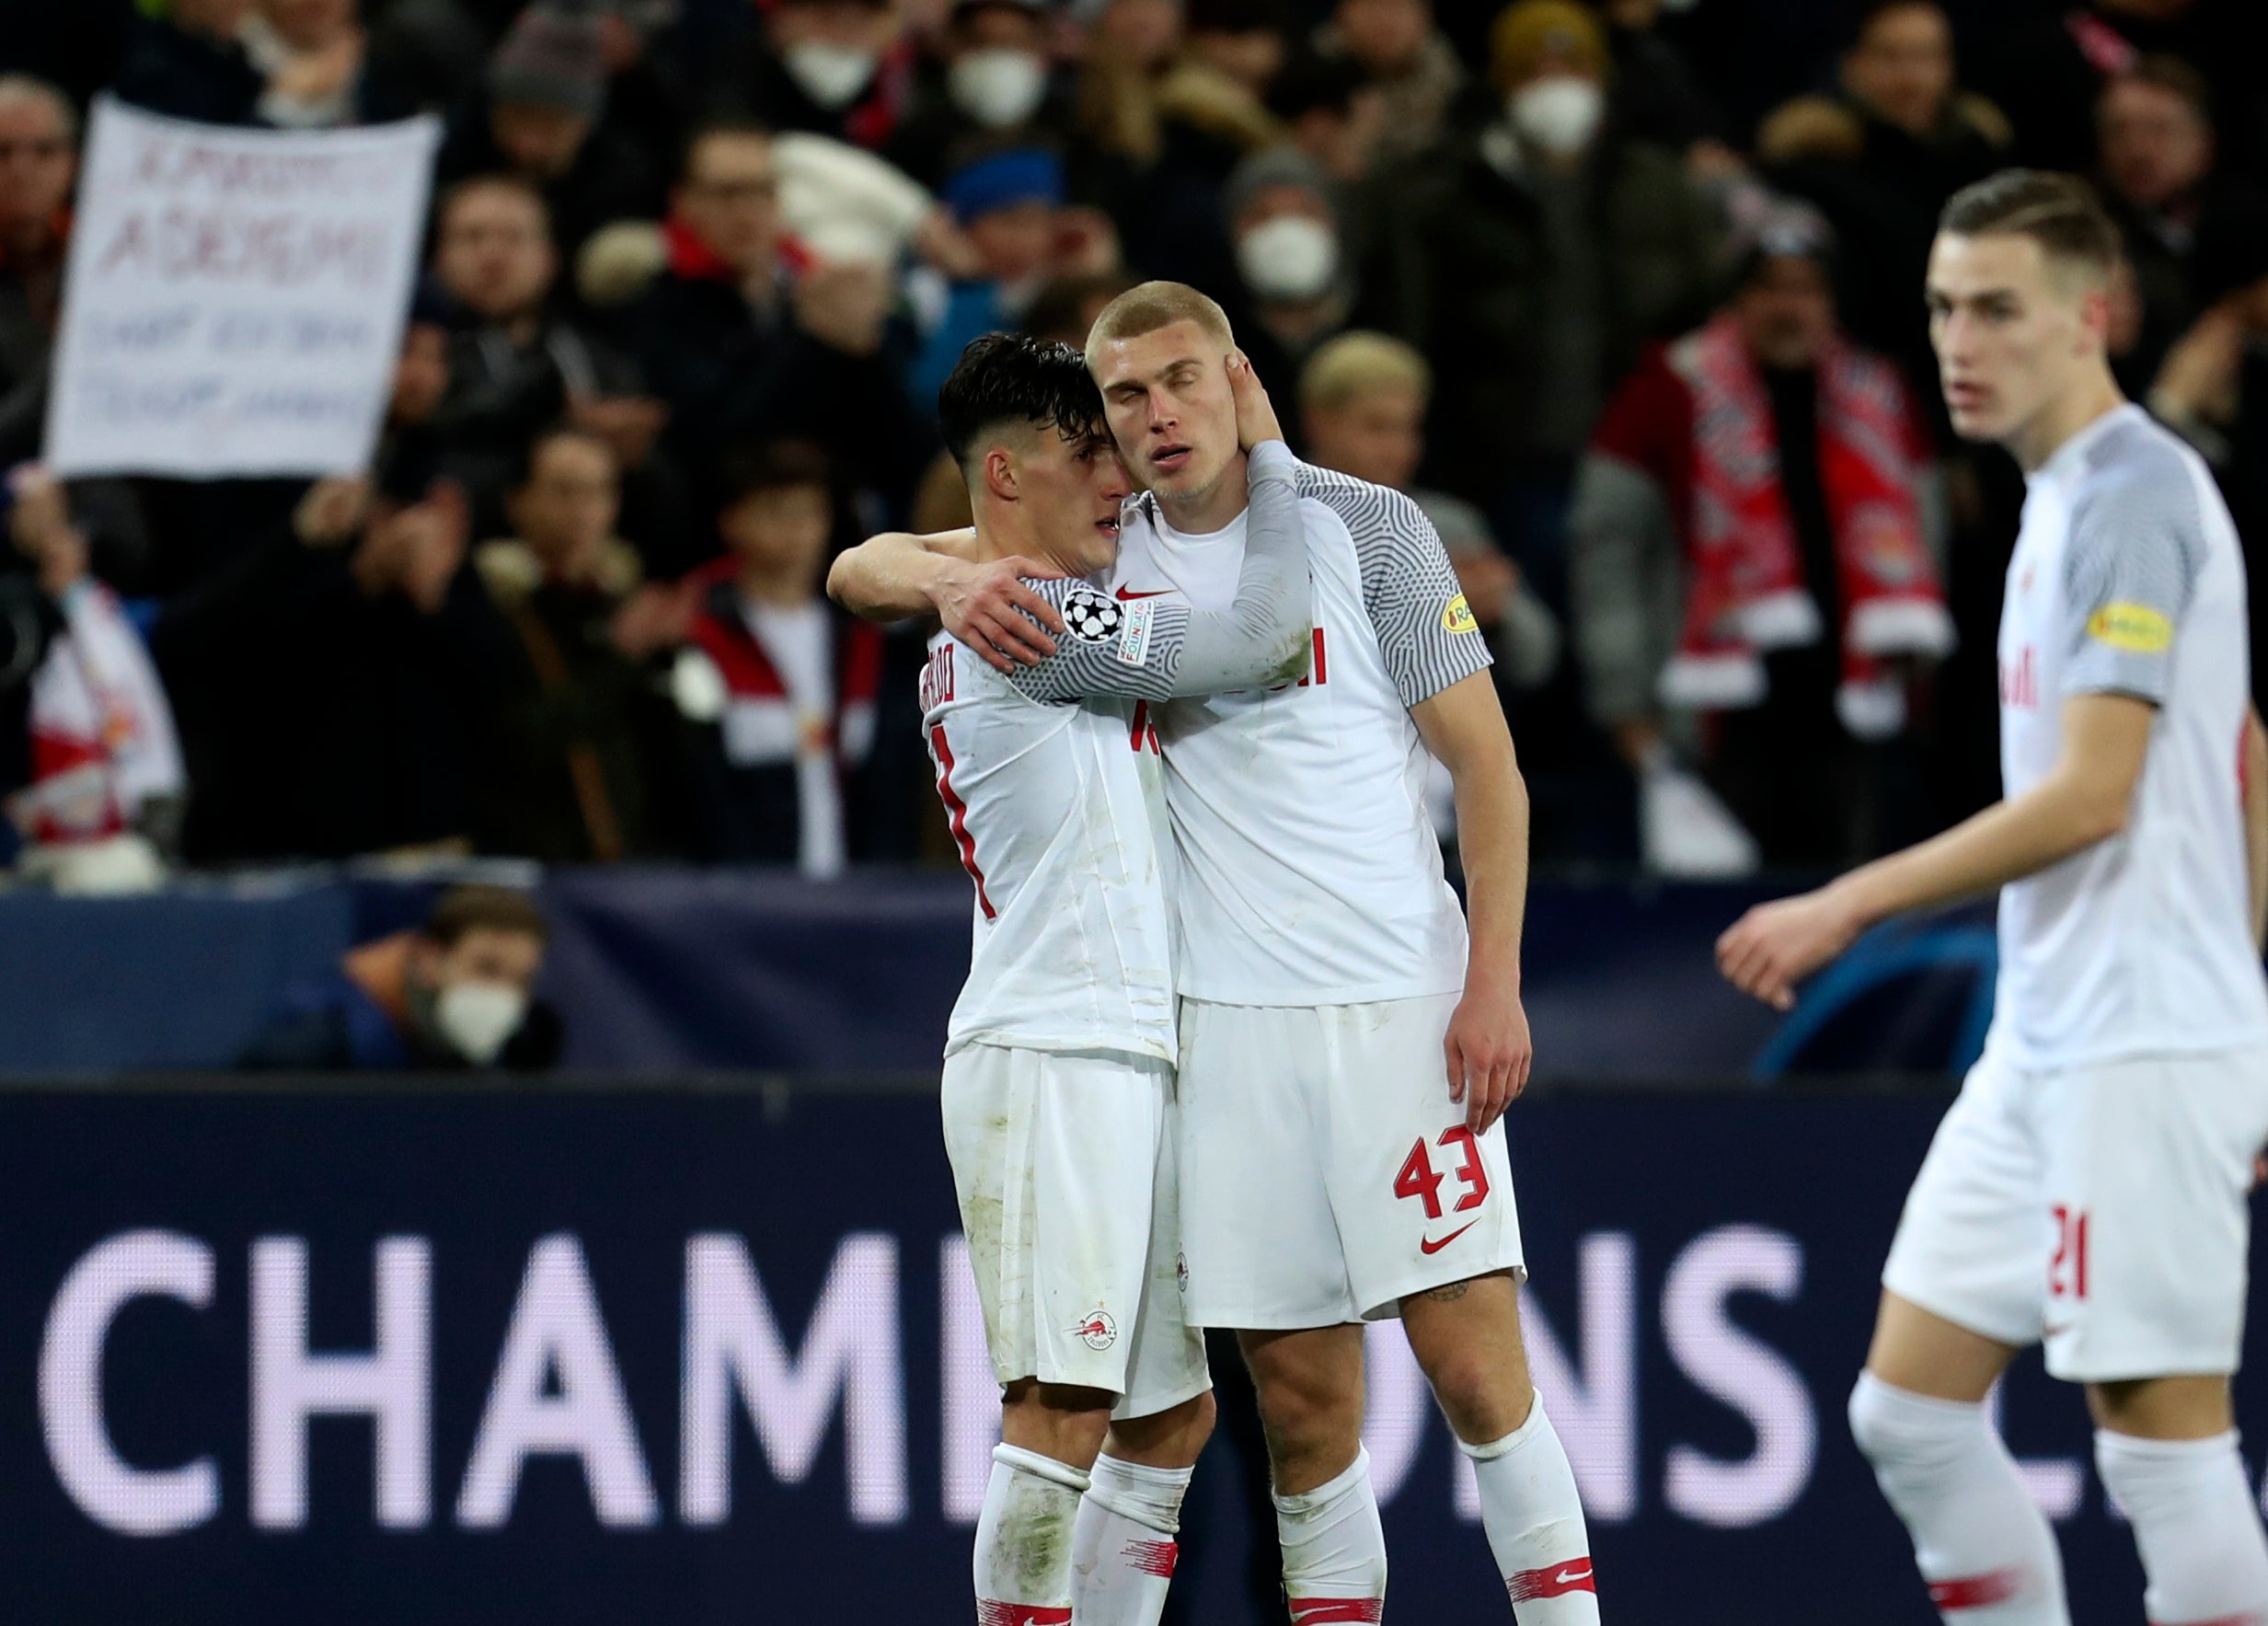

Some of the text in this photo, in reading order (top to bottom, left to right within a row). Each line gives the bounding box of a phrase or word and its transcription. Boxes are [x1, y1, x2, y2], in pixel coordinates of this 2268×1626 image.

[1393, 1123, 1490, 1220] 43
[2047, 1205, 2090, 1299] 21
[35, 1228, 1816, 1535] CHAMNS
